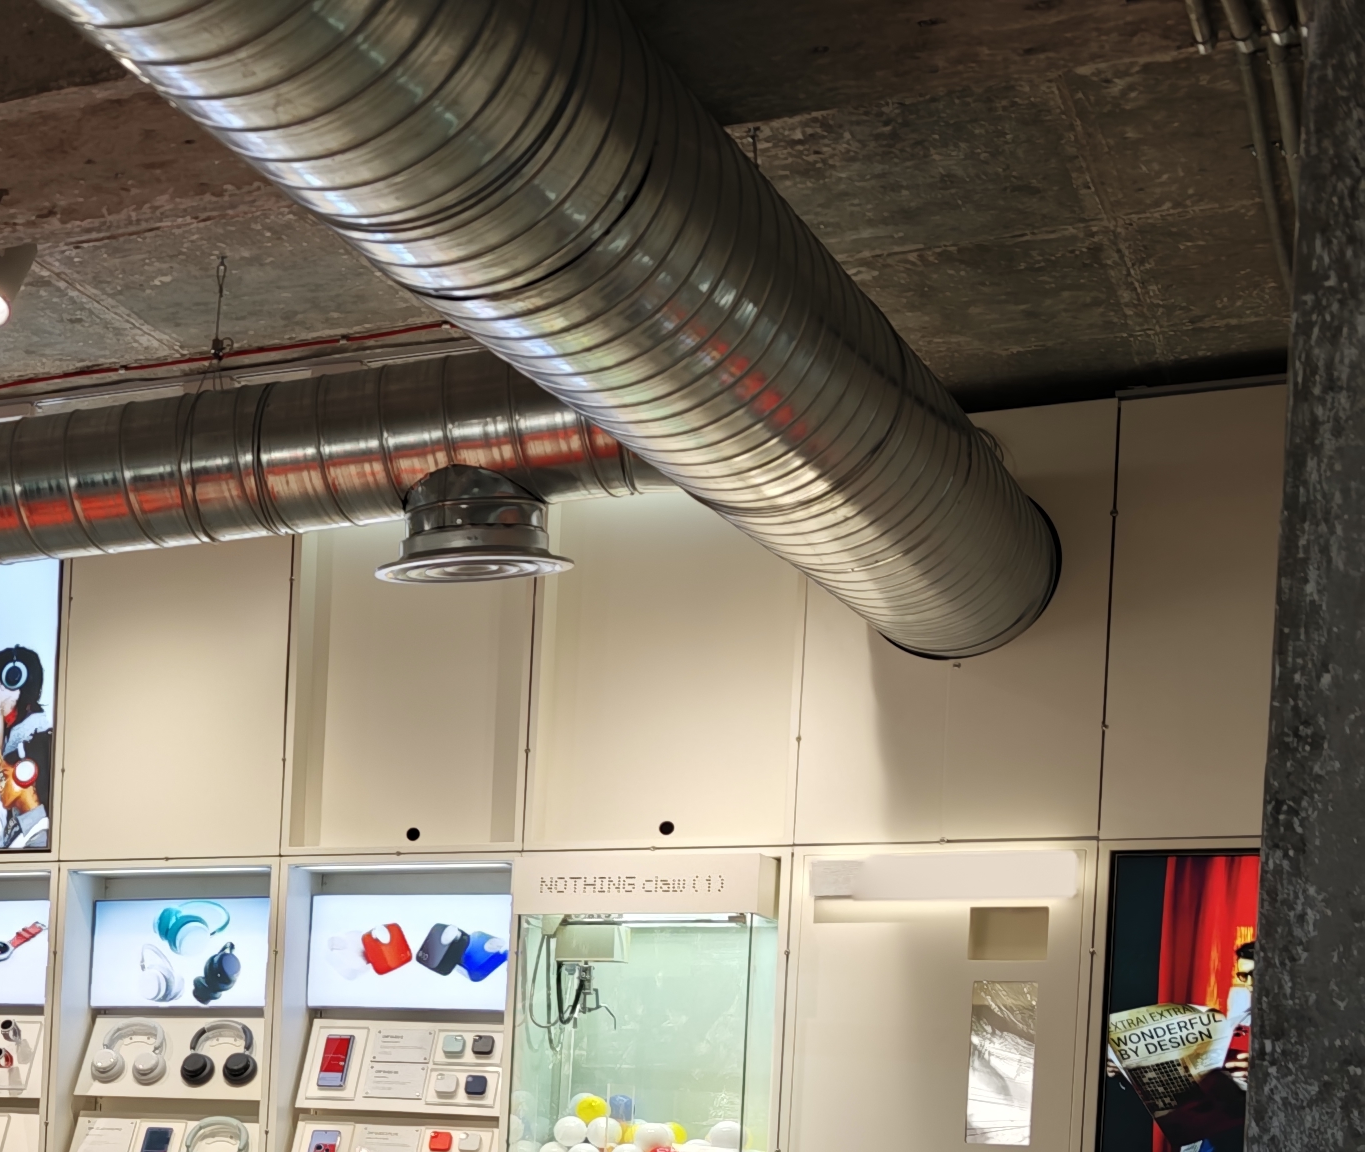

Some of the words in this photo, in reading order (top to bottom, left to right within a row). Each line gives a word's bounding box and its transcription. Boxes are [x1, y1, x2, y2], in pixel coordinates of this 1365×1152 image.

[540, 876, 636, 893] NOTHING
[642, 876, 686, 893] claw
[1110, 1013, 1222, 1048] WONDERFUL
[1118, 1046, 1140, 1061] BY
[1144, 1028, 1213, 1055] DESIGN
